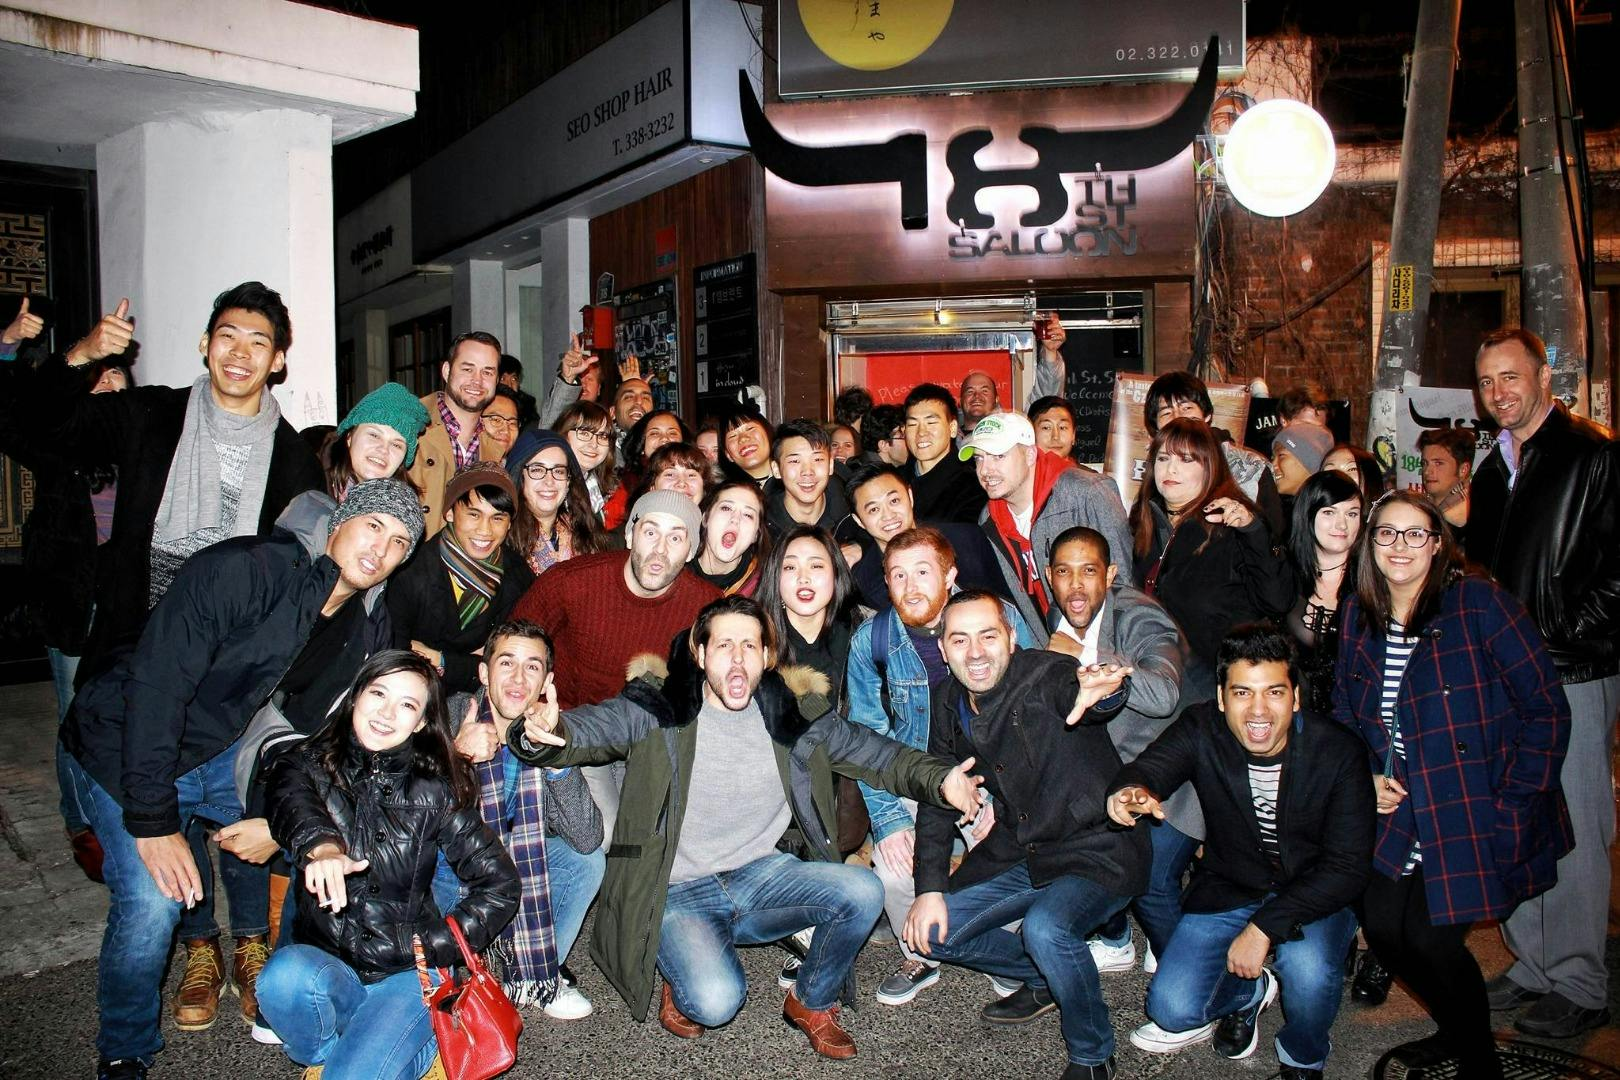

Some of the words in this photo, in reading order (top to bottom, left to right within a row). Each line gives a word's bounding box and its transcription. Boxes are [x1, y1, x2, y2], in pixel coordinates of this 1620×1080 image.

[567, 112, 591, 142] SEO
[594, 89, 630, 128] SHOP
[634, 66, 673, 106] HAIR
[612, 138, 623, 156] T.
[625, 112, 674, 152] 338-3232
[1074, 173, 1137, 206] TH
[1074, 200, 1137, 231] ST
[948, 229, 1137, 260] SALOON
[1391, 267, 1401, 309] 사다리차
[877, 382, 915, 402] Pleas
[1104, 370, 1115, 384] S
[1255, 414, 1279, 430] JAM
